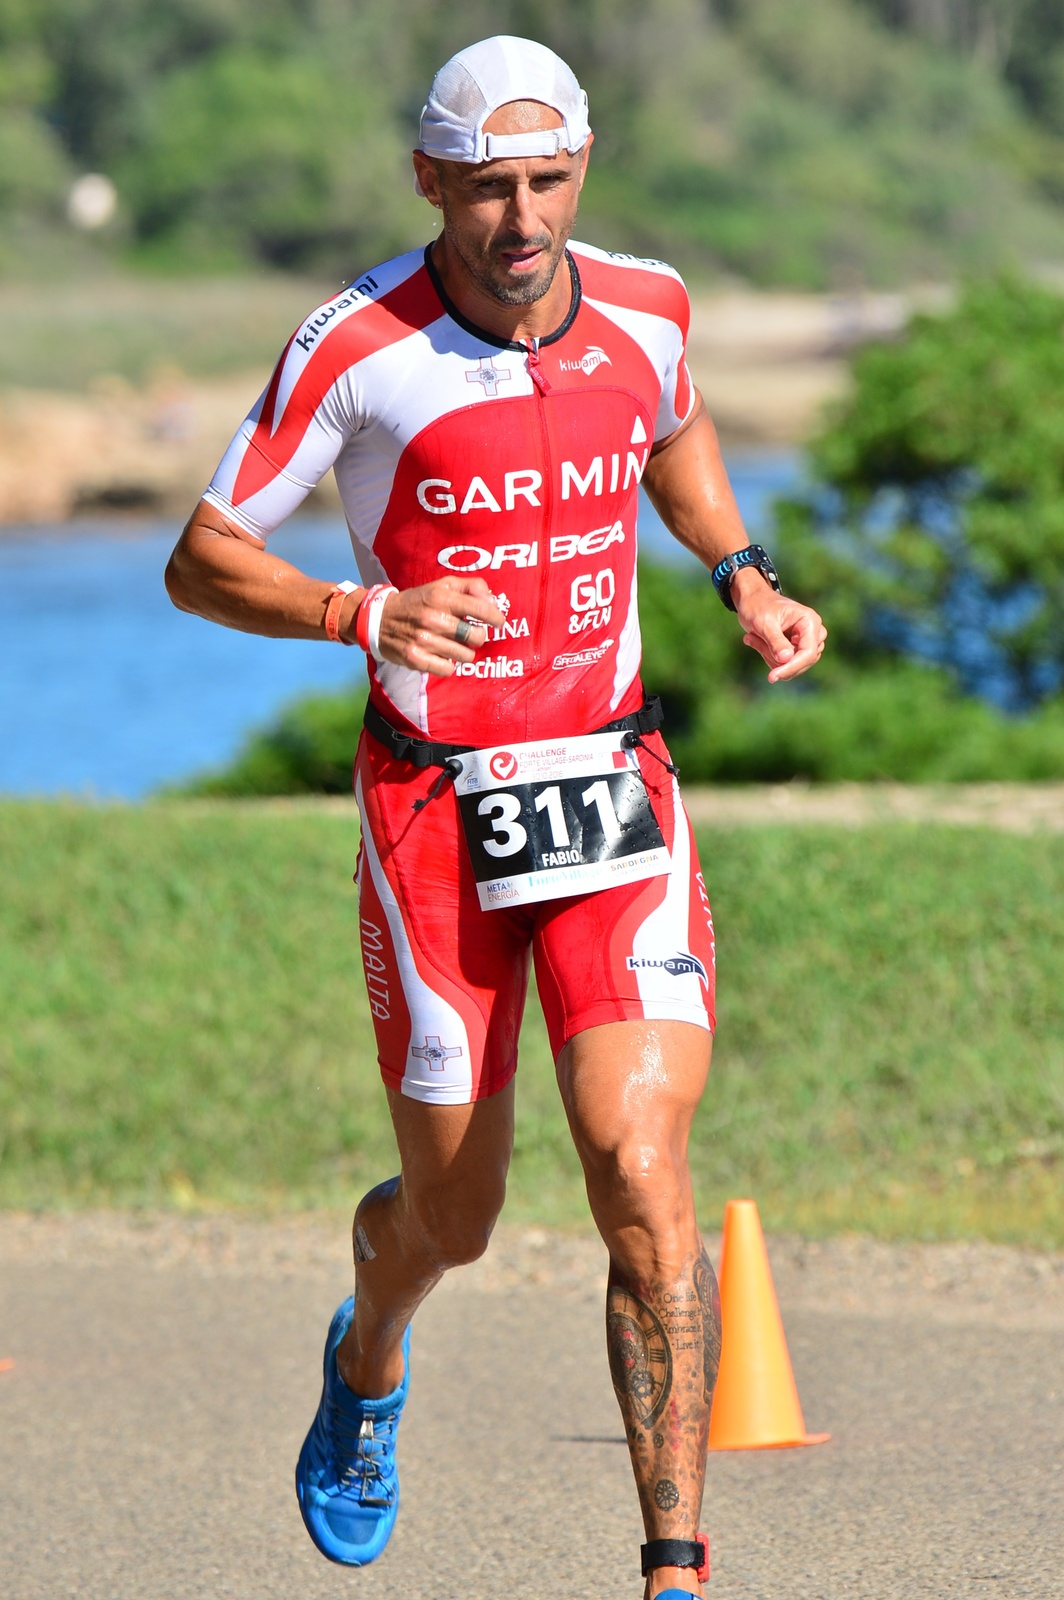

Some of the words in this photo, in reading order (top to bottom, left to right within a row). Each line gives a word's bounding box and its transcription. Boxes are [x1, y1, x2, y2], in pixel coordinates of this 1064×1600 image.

[295, 275, 379, 353] kiwami
[559, 352, 602, 372] kiwami
[416, 447, 648, 515] GARMIN
[570, 568, 615, 612] GO
[454, 655, 524, 679] ochika
[519, 747, 567, 760] CHALLENGE
[477, 780, 622, 858] 311
[541, 849, 580, 867] FABIO
[487, 882, 507, 894] META
[361, 918, 390, 1021] MALTA
[629, 957, 696, 973] kiwami
